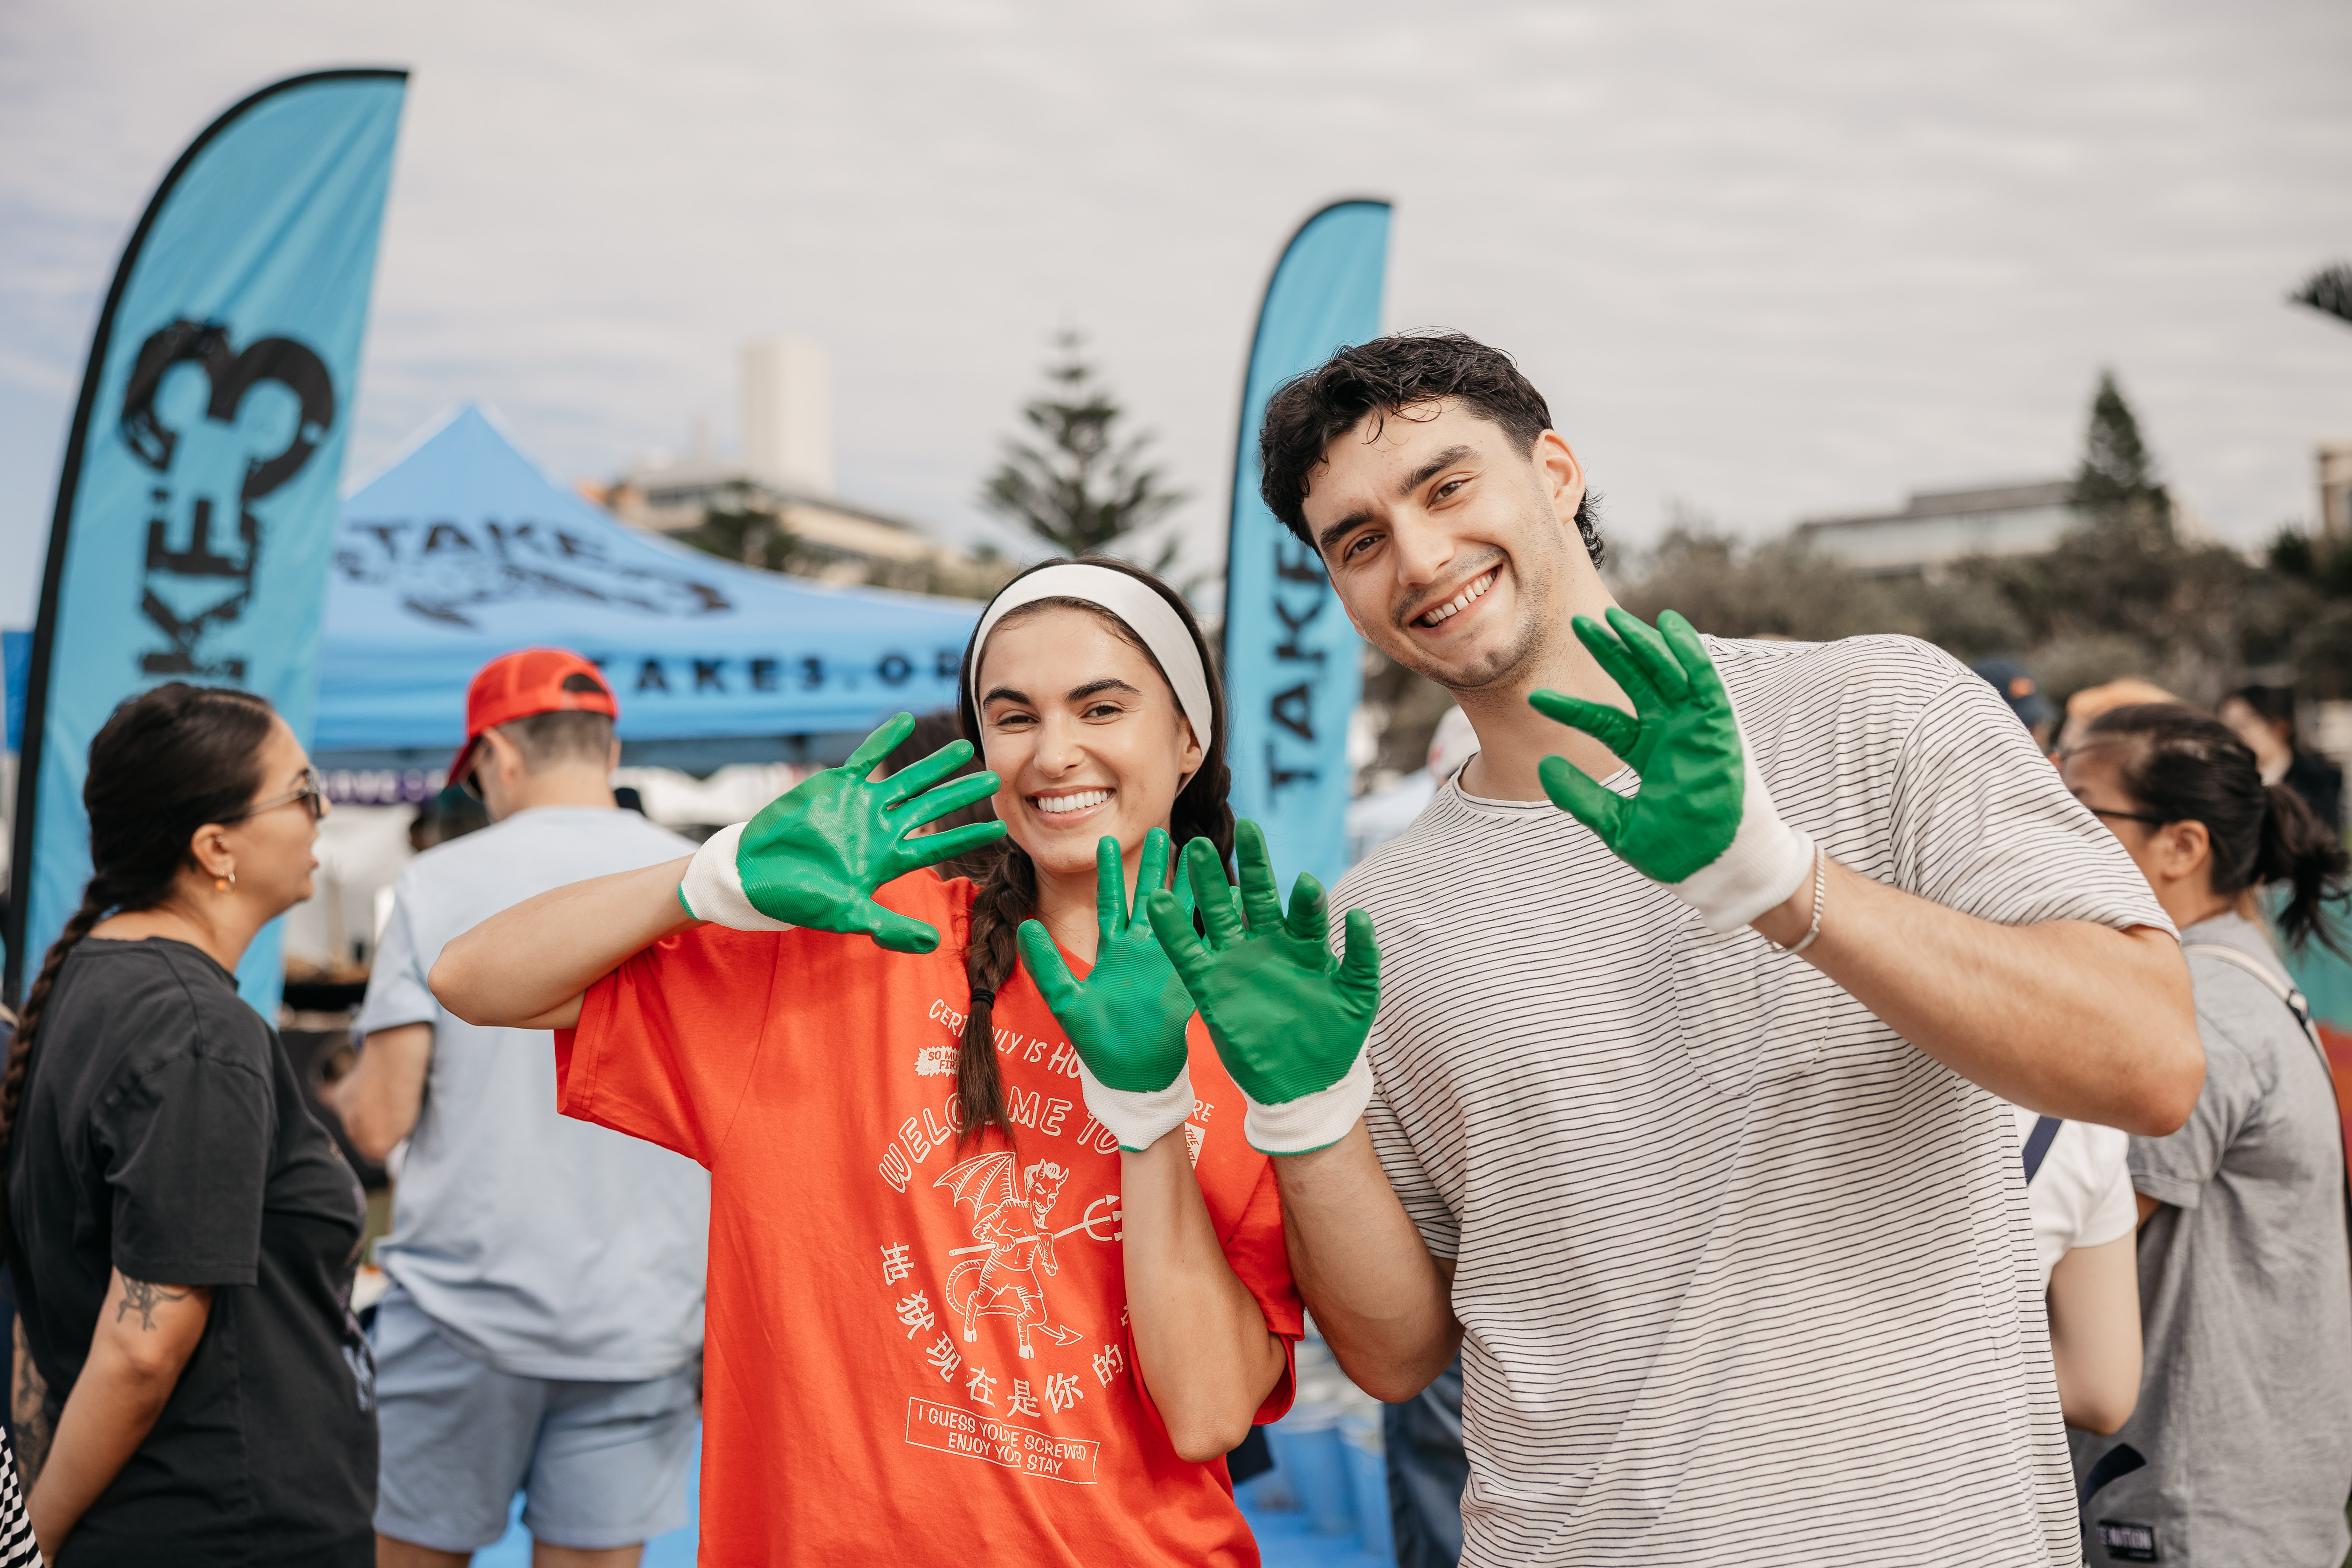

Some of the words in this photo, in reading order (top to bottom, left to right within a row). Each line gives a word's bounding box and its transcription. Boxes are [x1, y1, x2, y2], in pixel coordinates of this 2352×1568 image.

[928, 1050, 942, 1061] SO
[945, 1050, 957, 1061] MU
[939, 1060, 957, 1071] FIR
[1023, 1038, 1047, 1063] IS
[1047, 1041, 1080, 1079] HO
[1185, 1128, 1199, 1146] THE
[880, 1242, 1128, 1418] 地狱现在是你的
[918, 1405, 923, 1421] I
[928, 1407, 976, 1433] GUESS
[1024, 1434, 1087, 1461] SCREWED
[949, 1432, 991, 1456] ENJOY
[1027, 1454, 1063, 1475] STAY
